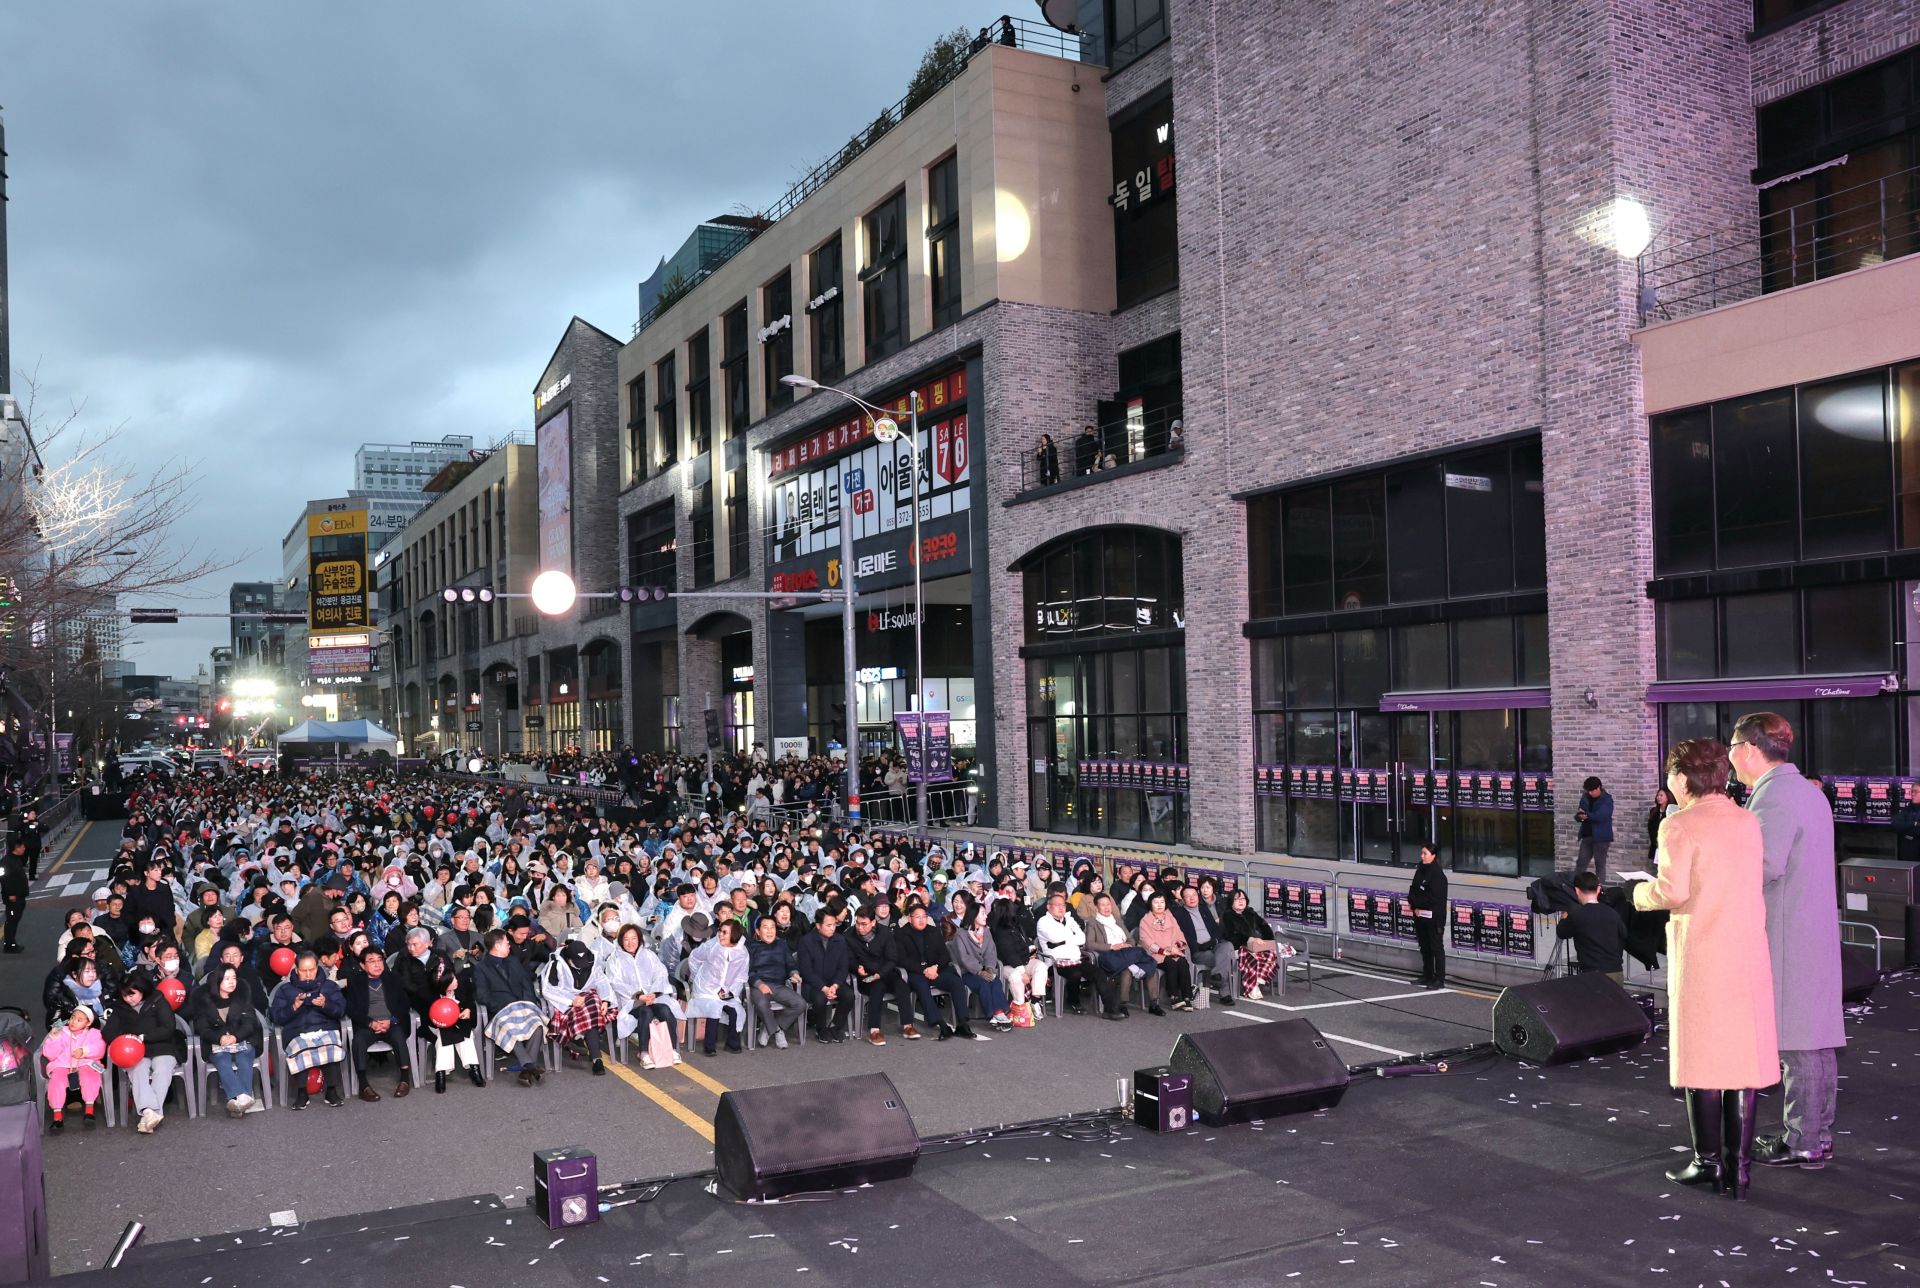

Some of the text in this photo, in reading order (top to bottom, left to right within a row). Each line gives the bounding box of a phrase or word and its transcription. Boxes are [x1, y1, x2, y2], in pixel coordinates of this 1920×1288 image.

[939, 422, 964, 442] SALE
[323, 563, 356, 578] 산부인과
[840, 549, 897, 580] 나로마트
[323, 576, 356, 590] 수술전문
[316, 606, 362, 622] 여의사 진료
